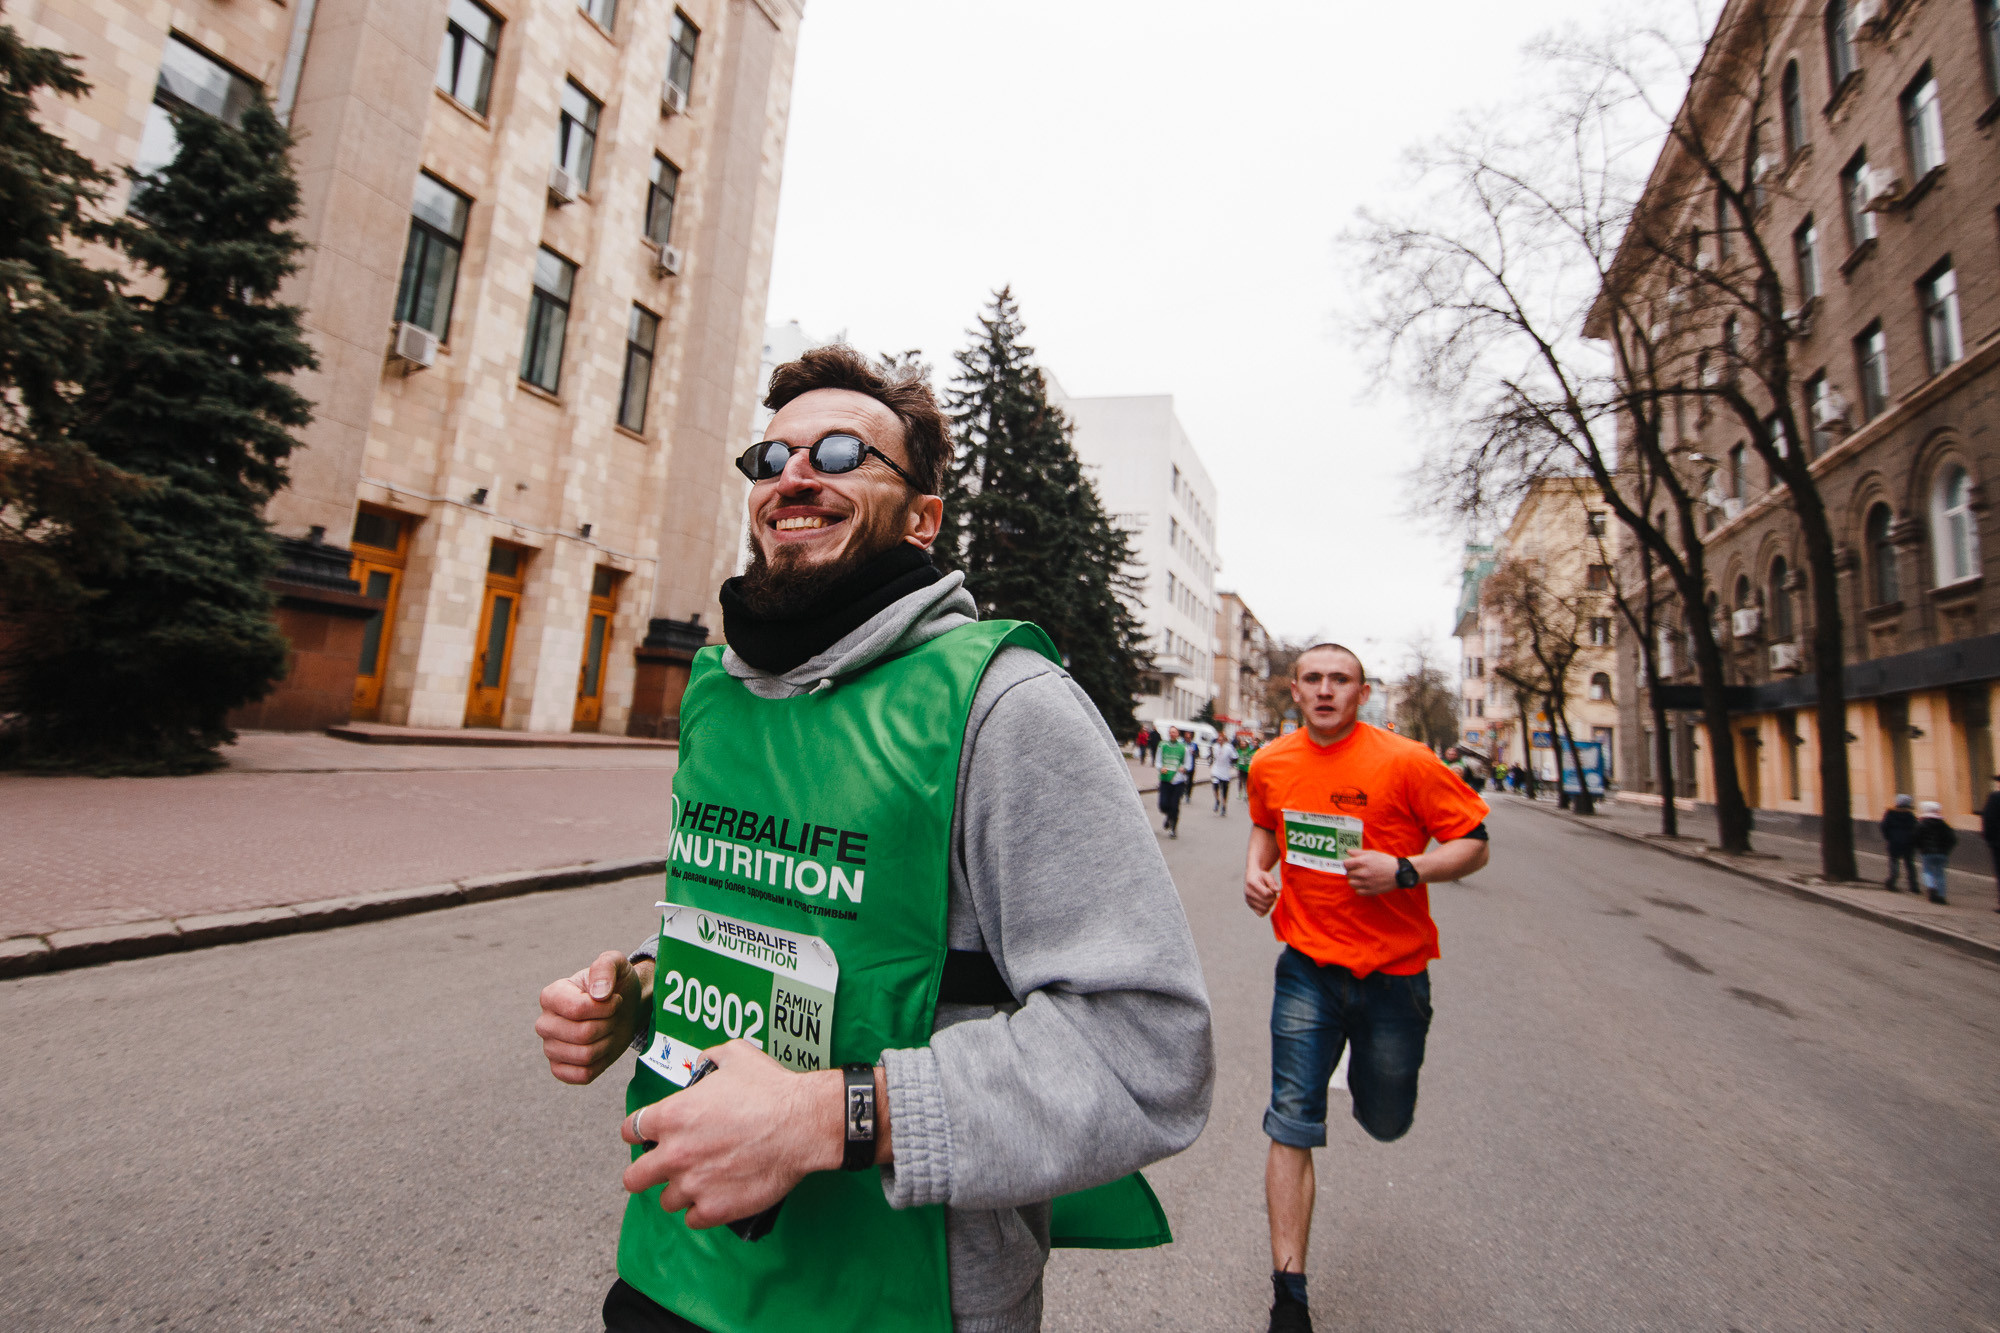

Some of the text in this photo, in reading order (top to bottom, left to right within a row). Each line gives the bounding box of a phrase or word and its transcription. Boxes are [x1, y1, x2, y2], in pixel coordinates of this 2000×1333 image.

[679, 800, 869, 865] HERBALIFE
[1287, 829, 1336, 853] 22072
[1338, 837, 1359, 848] RUN
[672, 831, 865, 904] NUTRITION
[671, 866, 858, 922] Мы делаем мир более здоровым и счастливым
[717, 919, 798, 956] HERBALIFE
[717, 934, 798, 971] NUTRITION
[662, 970, 764, 1050] 20902
[775, 988, 823, 1018] FAMILY
[774, 1005, 821, 1046] RUN
[773, 1039, 793, 1063] 1,6
